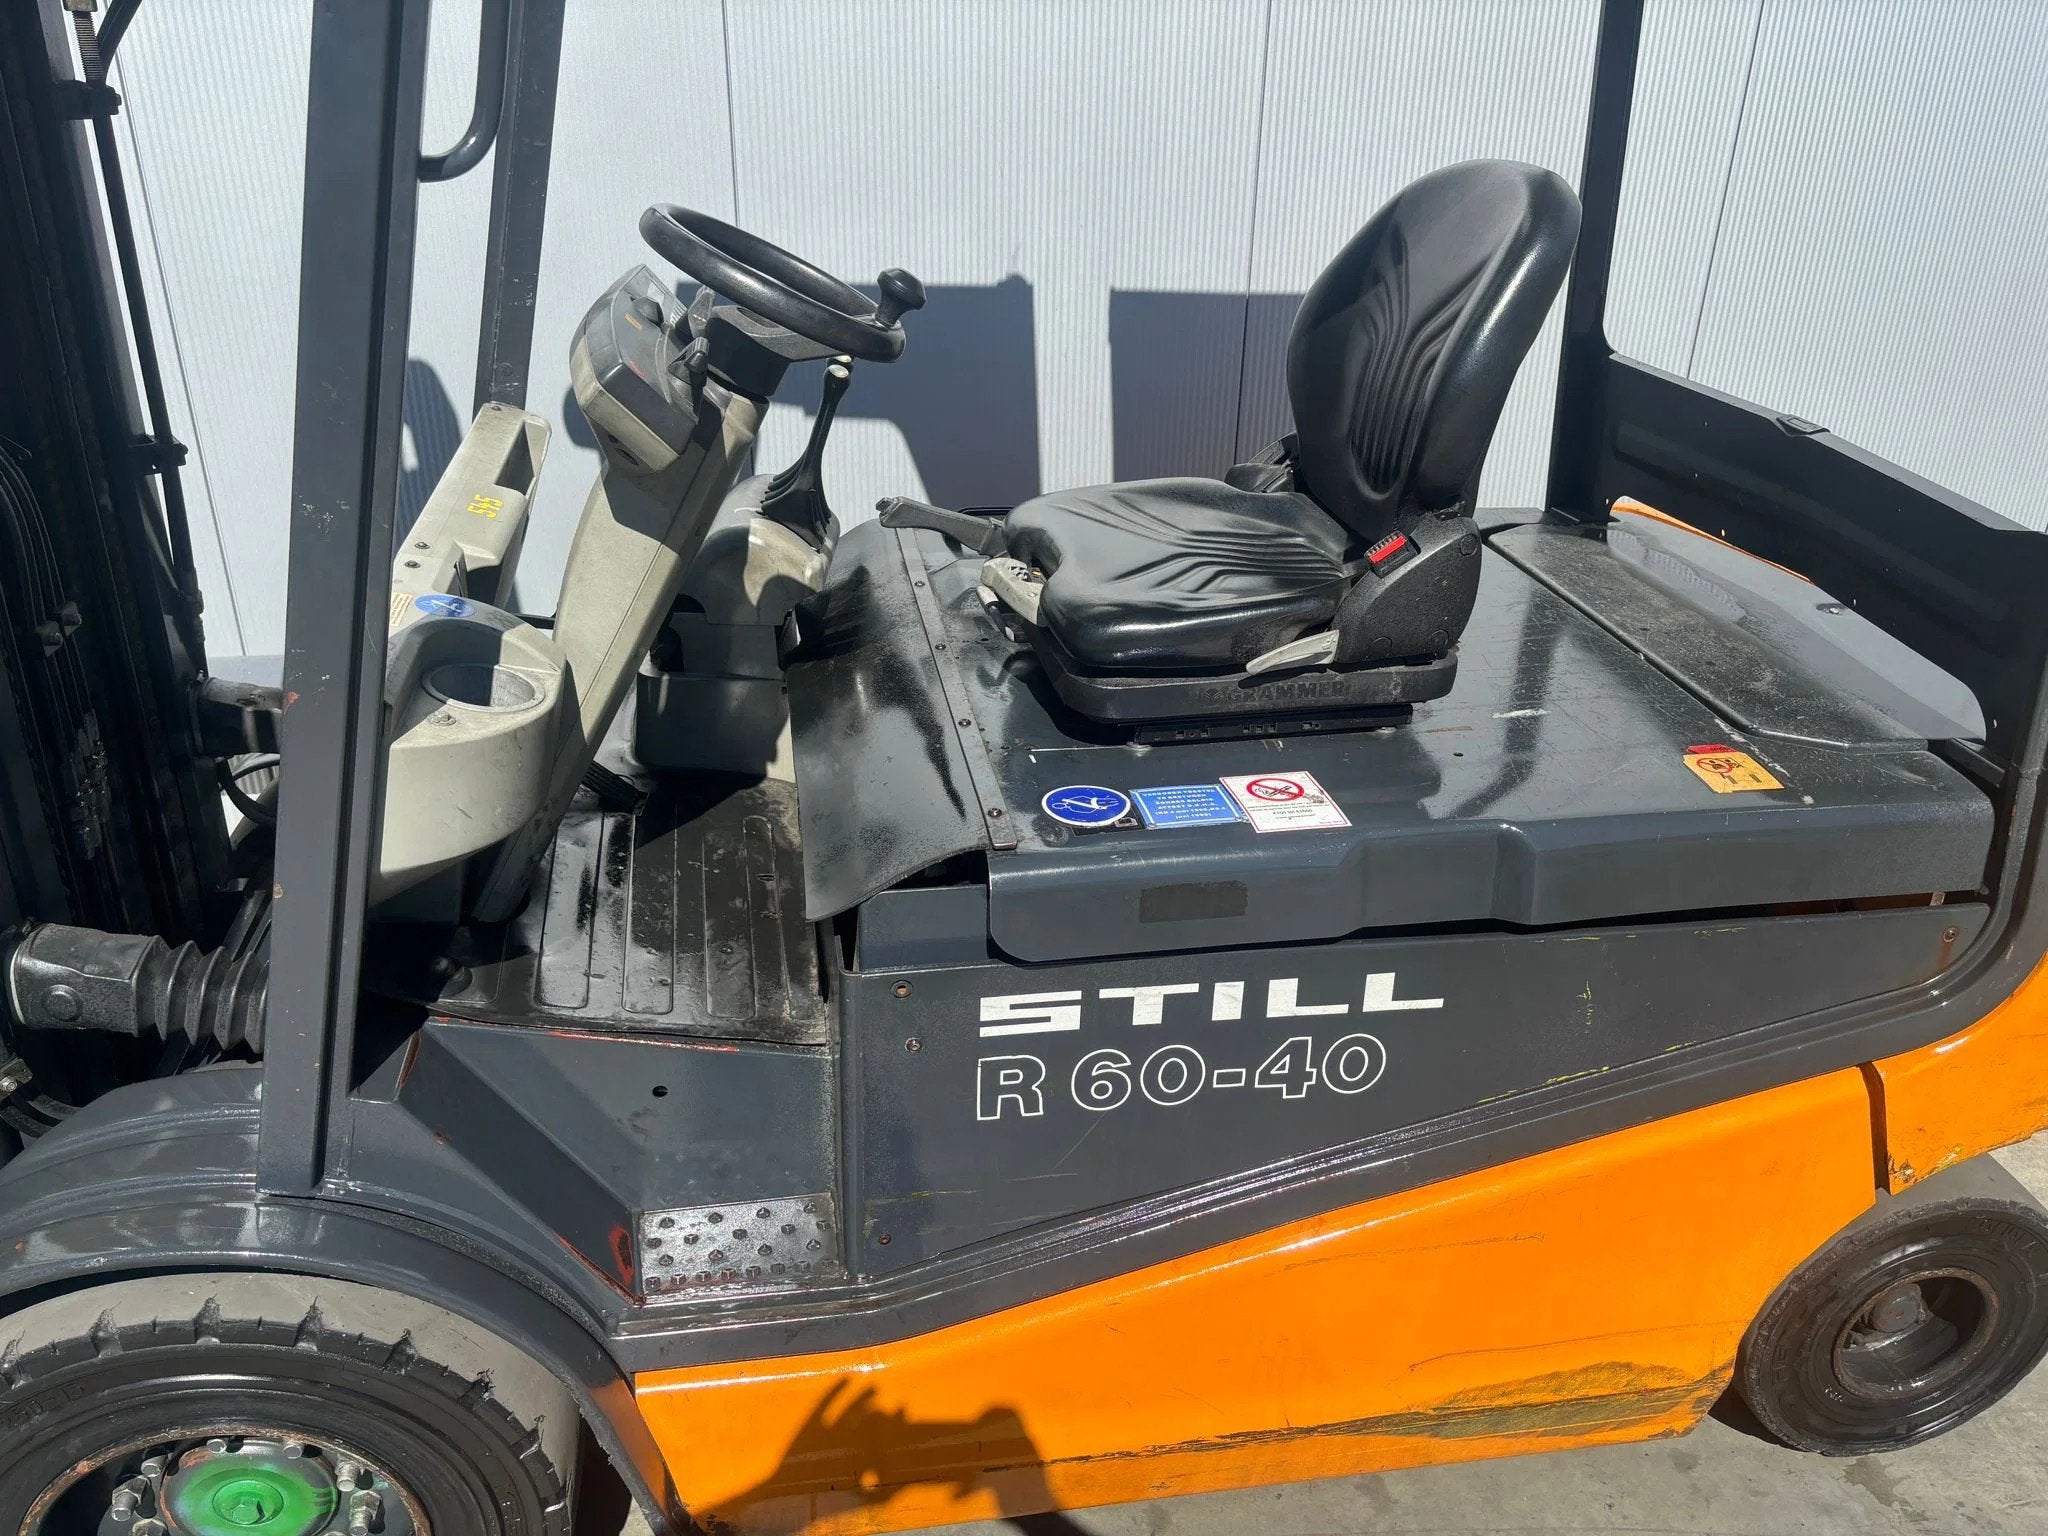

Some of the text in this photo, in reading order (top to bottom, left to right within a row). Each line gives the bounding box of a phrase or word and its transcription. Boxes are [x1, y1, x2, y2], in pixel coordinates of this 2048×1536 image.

[1227, 680, 1346, 703] GRAMMER
[980, 972, 1444, 1037] STILL
[977, 1033, 1387, 1121] R 60-40
